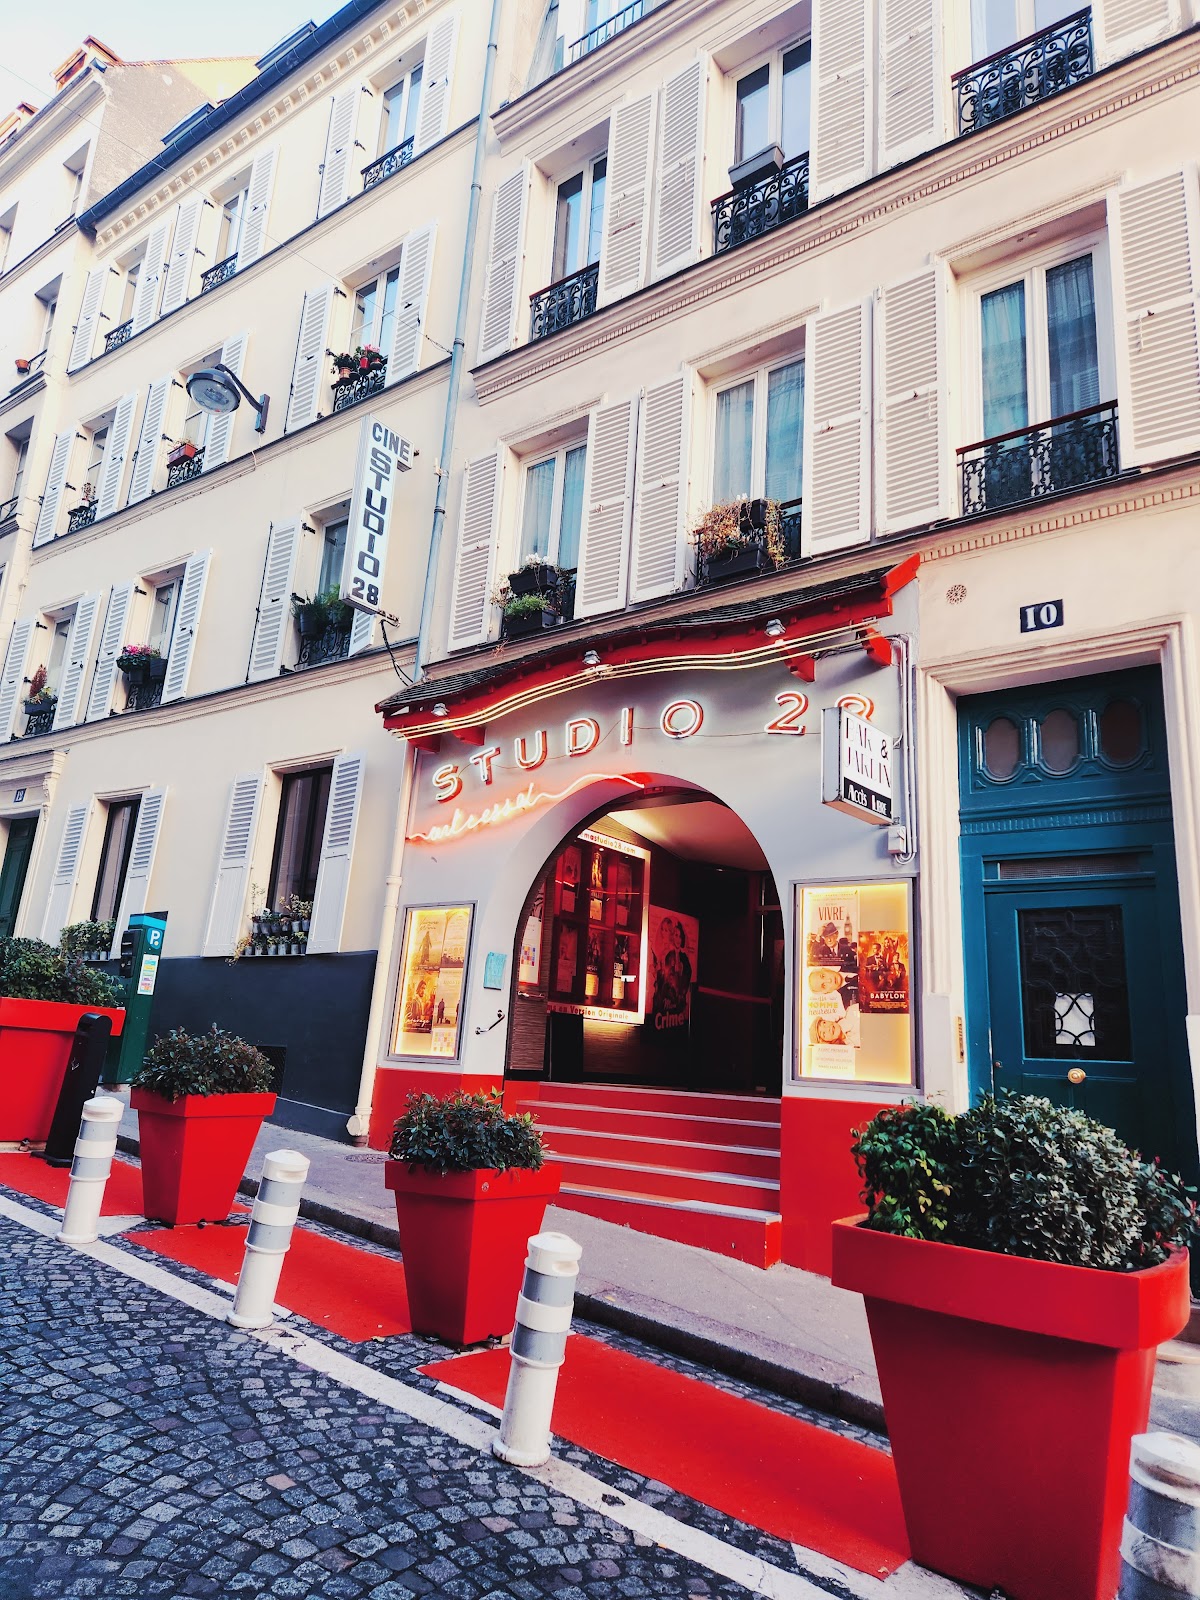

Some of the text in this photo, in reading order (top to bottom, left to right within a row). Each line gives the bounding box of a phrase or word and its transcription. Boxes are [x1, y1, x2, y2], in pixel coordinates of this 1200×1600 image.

[372, 422, 411, 463] CINE
[357, 447, 392, 579] STUDIO
[351, 576, 380, 606] 28
[1025, 603, 1058, 629] 10
[432, 699, 705, 802] STUDIO
[845, 717, 889, 760] BAR &
[844, 746, 891, 788] JARDIN
[818, 906, 845, 921] VIVRE
[149, 929, 161, 945] P
[870, 992, 905, 1000] BABYLON
[569, 1005, 596, 1016] Version
[598, 1009, 629, 1020] Originale
[654, 1010, 685, 1030] Crime
